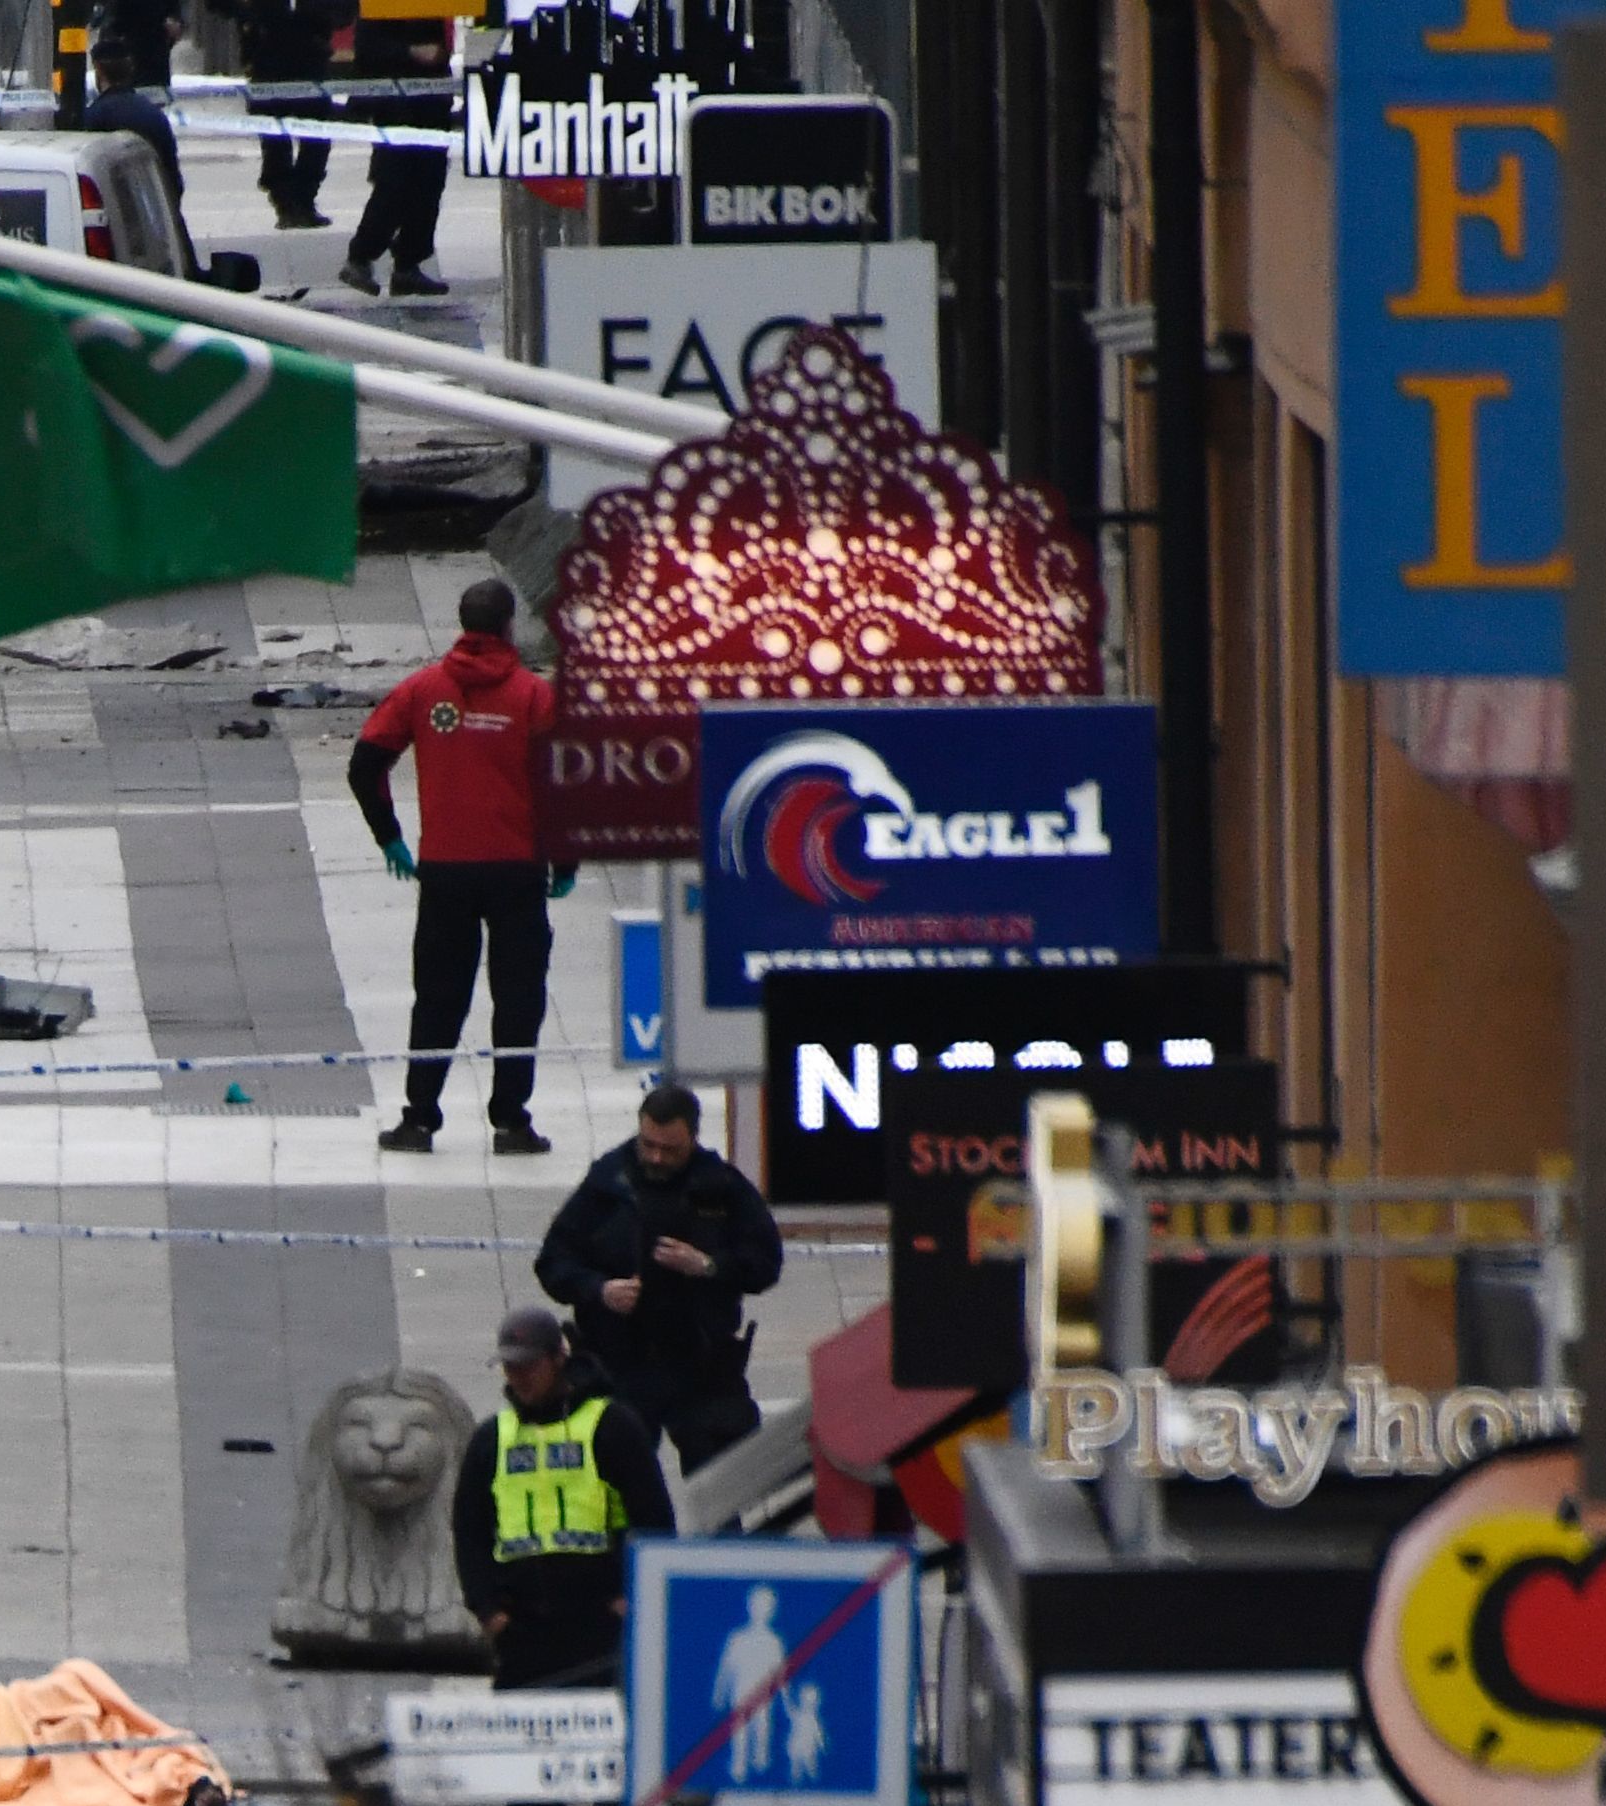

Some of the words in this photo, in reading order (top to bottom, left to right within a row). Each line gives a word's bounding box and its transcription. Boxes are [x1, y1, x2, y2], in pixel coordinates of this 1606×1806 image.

[704, 183, 777, 226] BIK
[780, 183, 876, 226] BOK
[1386, 0, 1575, 590] EL
[909, 1133, 1168, 1173] STOCM
[1180, 1131, 1260, 1171] INN
[1091, 1717, 1359, 1781] TEATER
